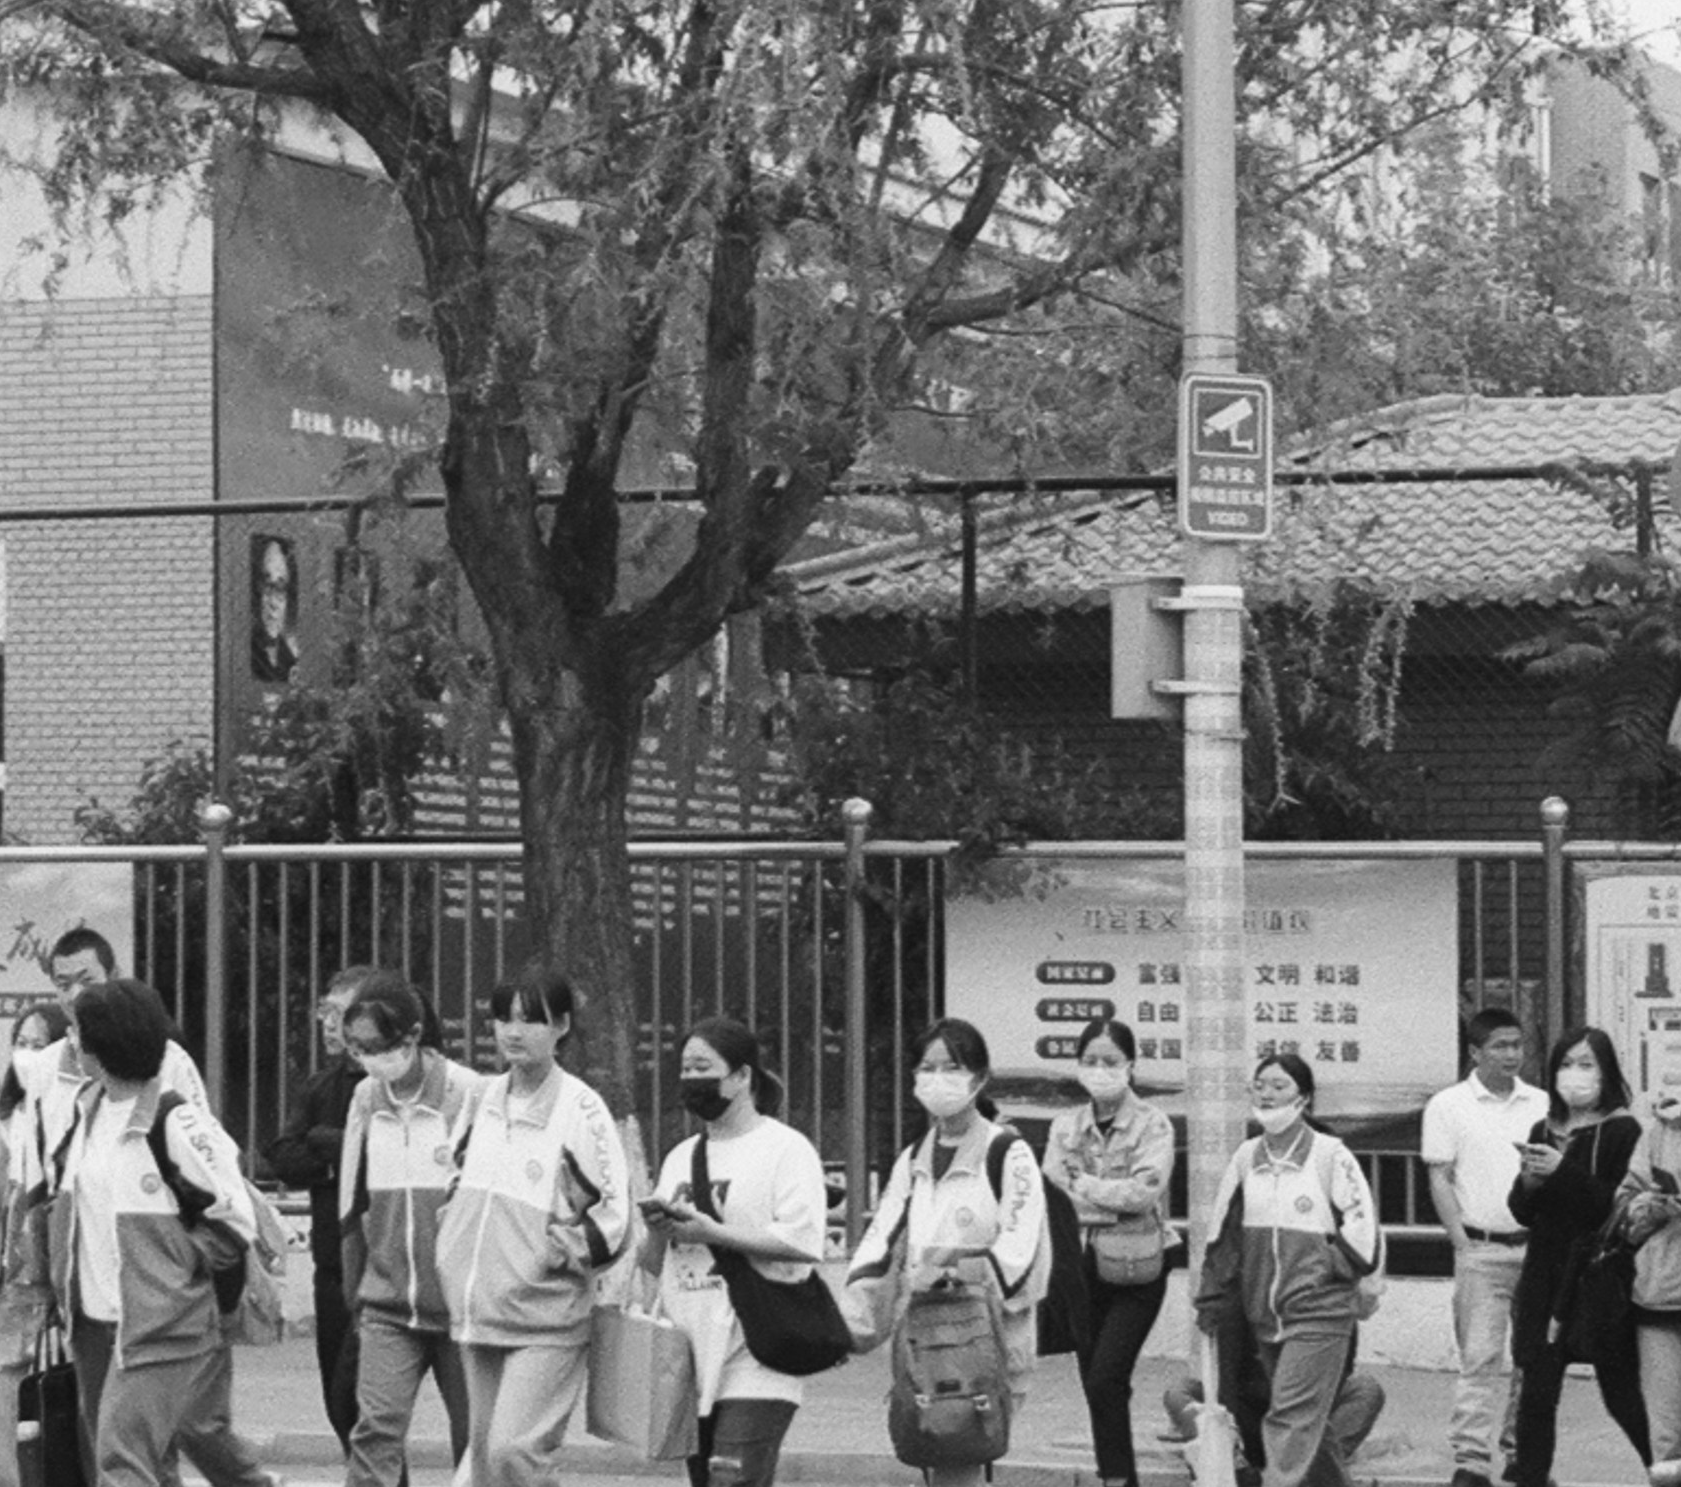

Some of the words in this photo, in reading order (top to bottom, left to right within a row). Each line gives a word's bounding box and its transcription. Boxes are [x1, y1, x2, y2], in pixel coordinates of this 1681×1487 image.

[1139, 964, 1181, 985] 富强
[1255, 964, 1299, 986] 文明
[1314, 964, 1360, 986] 和谐
[1138, 1001, 1180, 1023] 自由
[1254, 1001, 1299, 1024] 公正
[1314, 1001, 1359, 1024] 法治
[1139, 1038, 1182, 1060] 爱国
[1315, 1040, 1361, 1062] 友善
